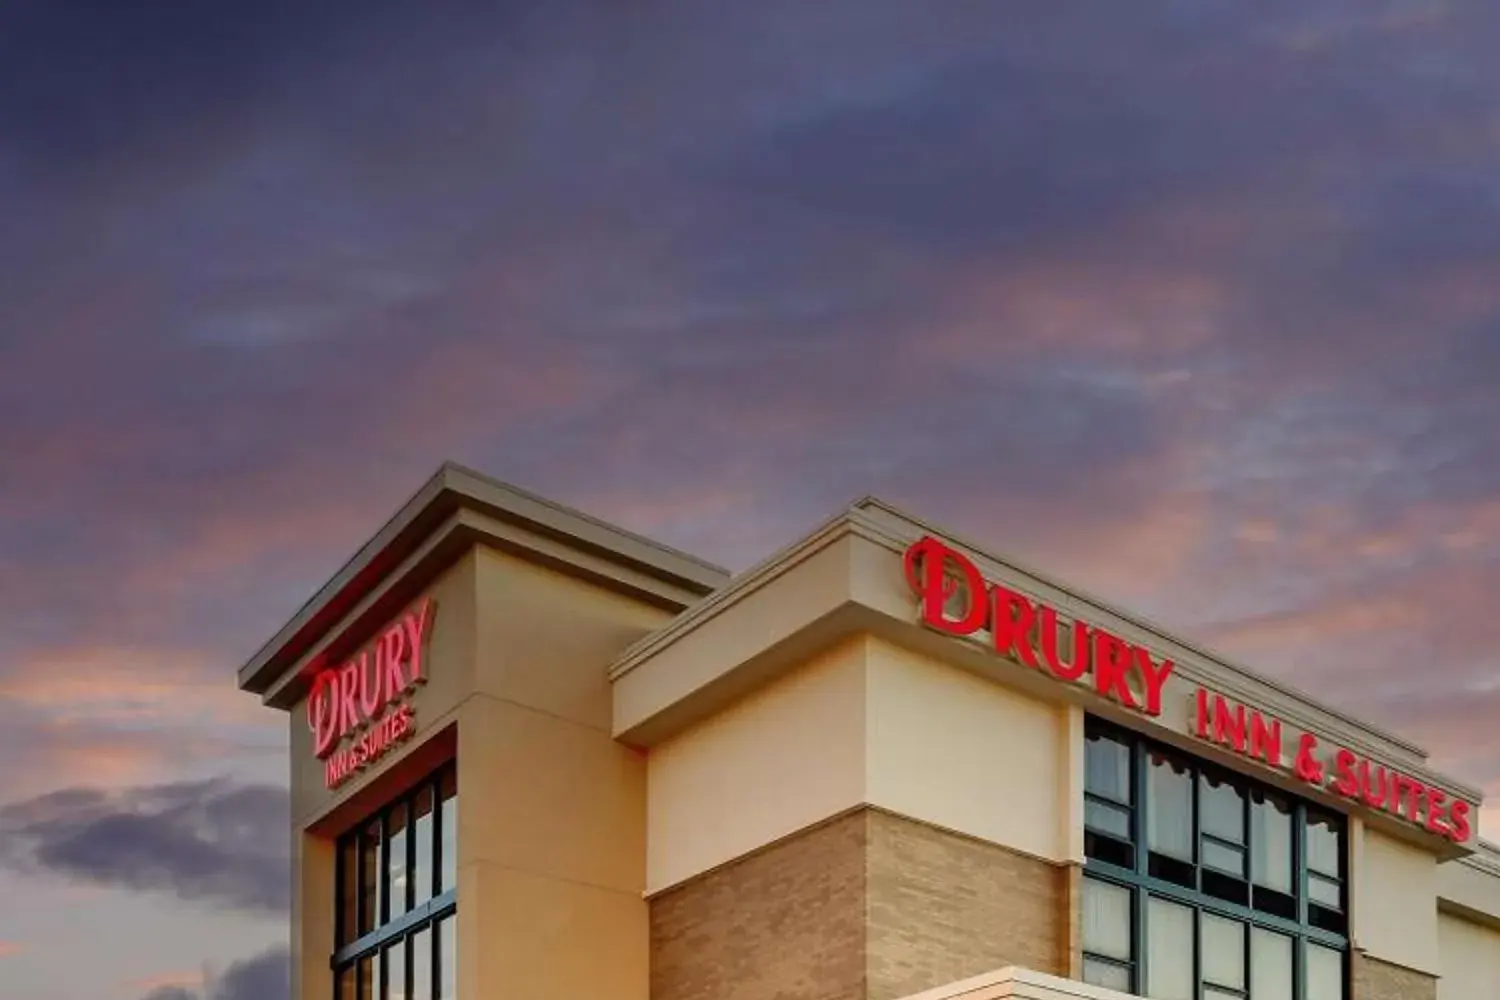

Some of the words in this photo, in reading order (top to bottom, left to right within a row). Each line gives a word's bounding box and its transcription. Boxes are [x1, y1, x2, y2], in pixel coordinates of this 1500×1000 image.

[307, 597, 432, 756] DRURY
[325, 751, 348, 789] INN
[360, 704, 411, 762] SUITES
[903, 535, 1174, 716] DRURY
[1195, 686, 1281, 767] INN
[1294, 733, 1325, 784] &
[1332, 748, 1471, 843] SUITES
